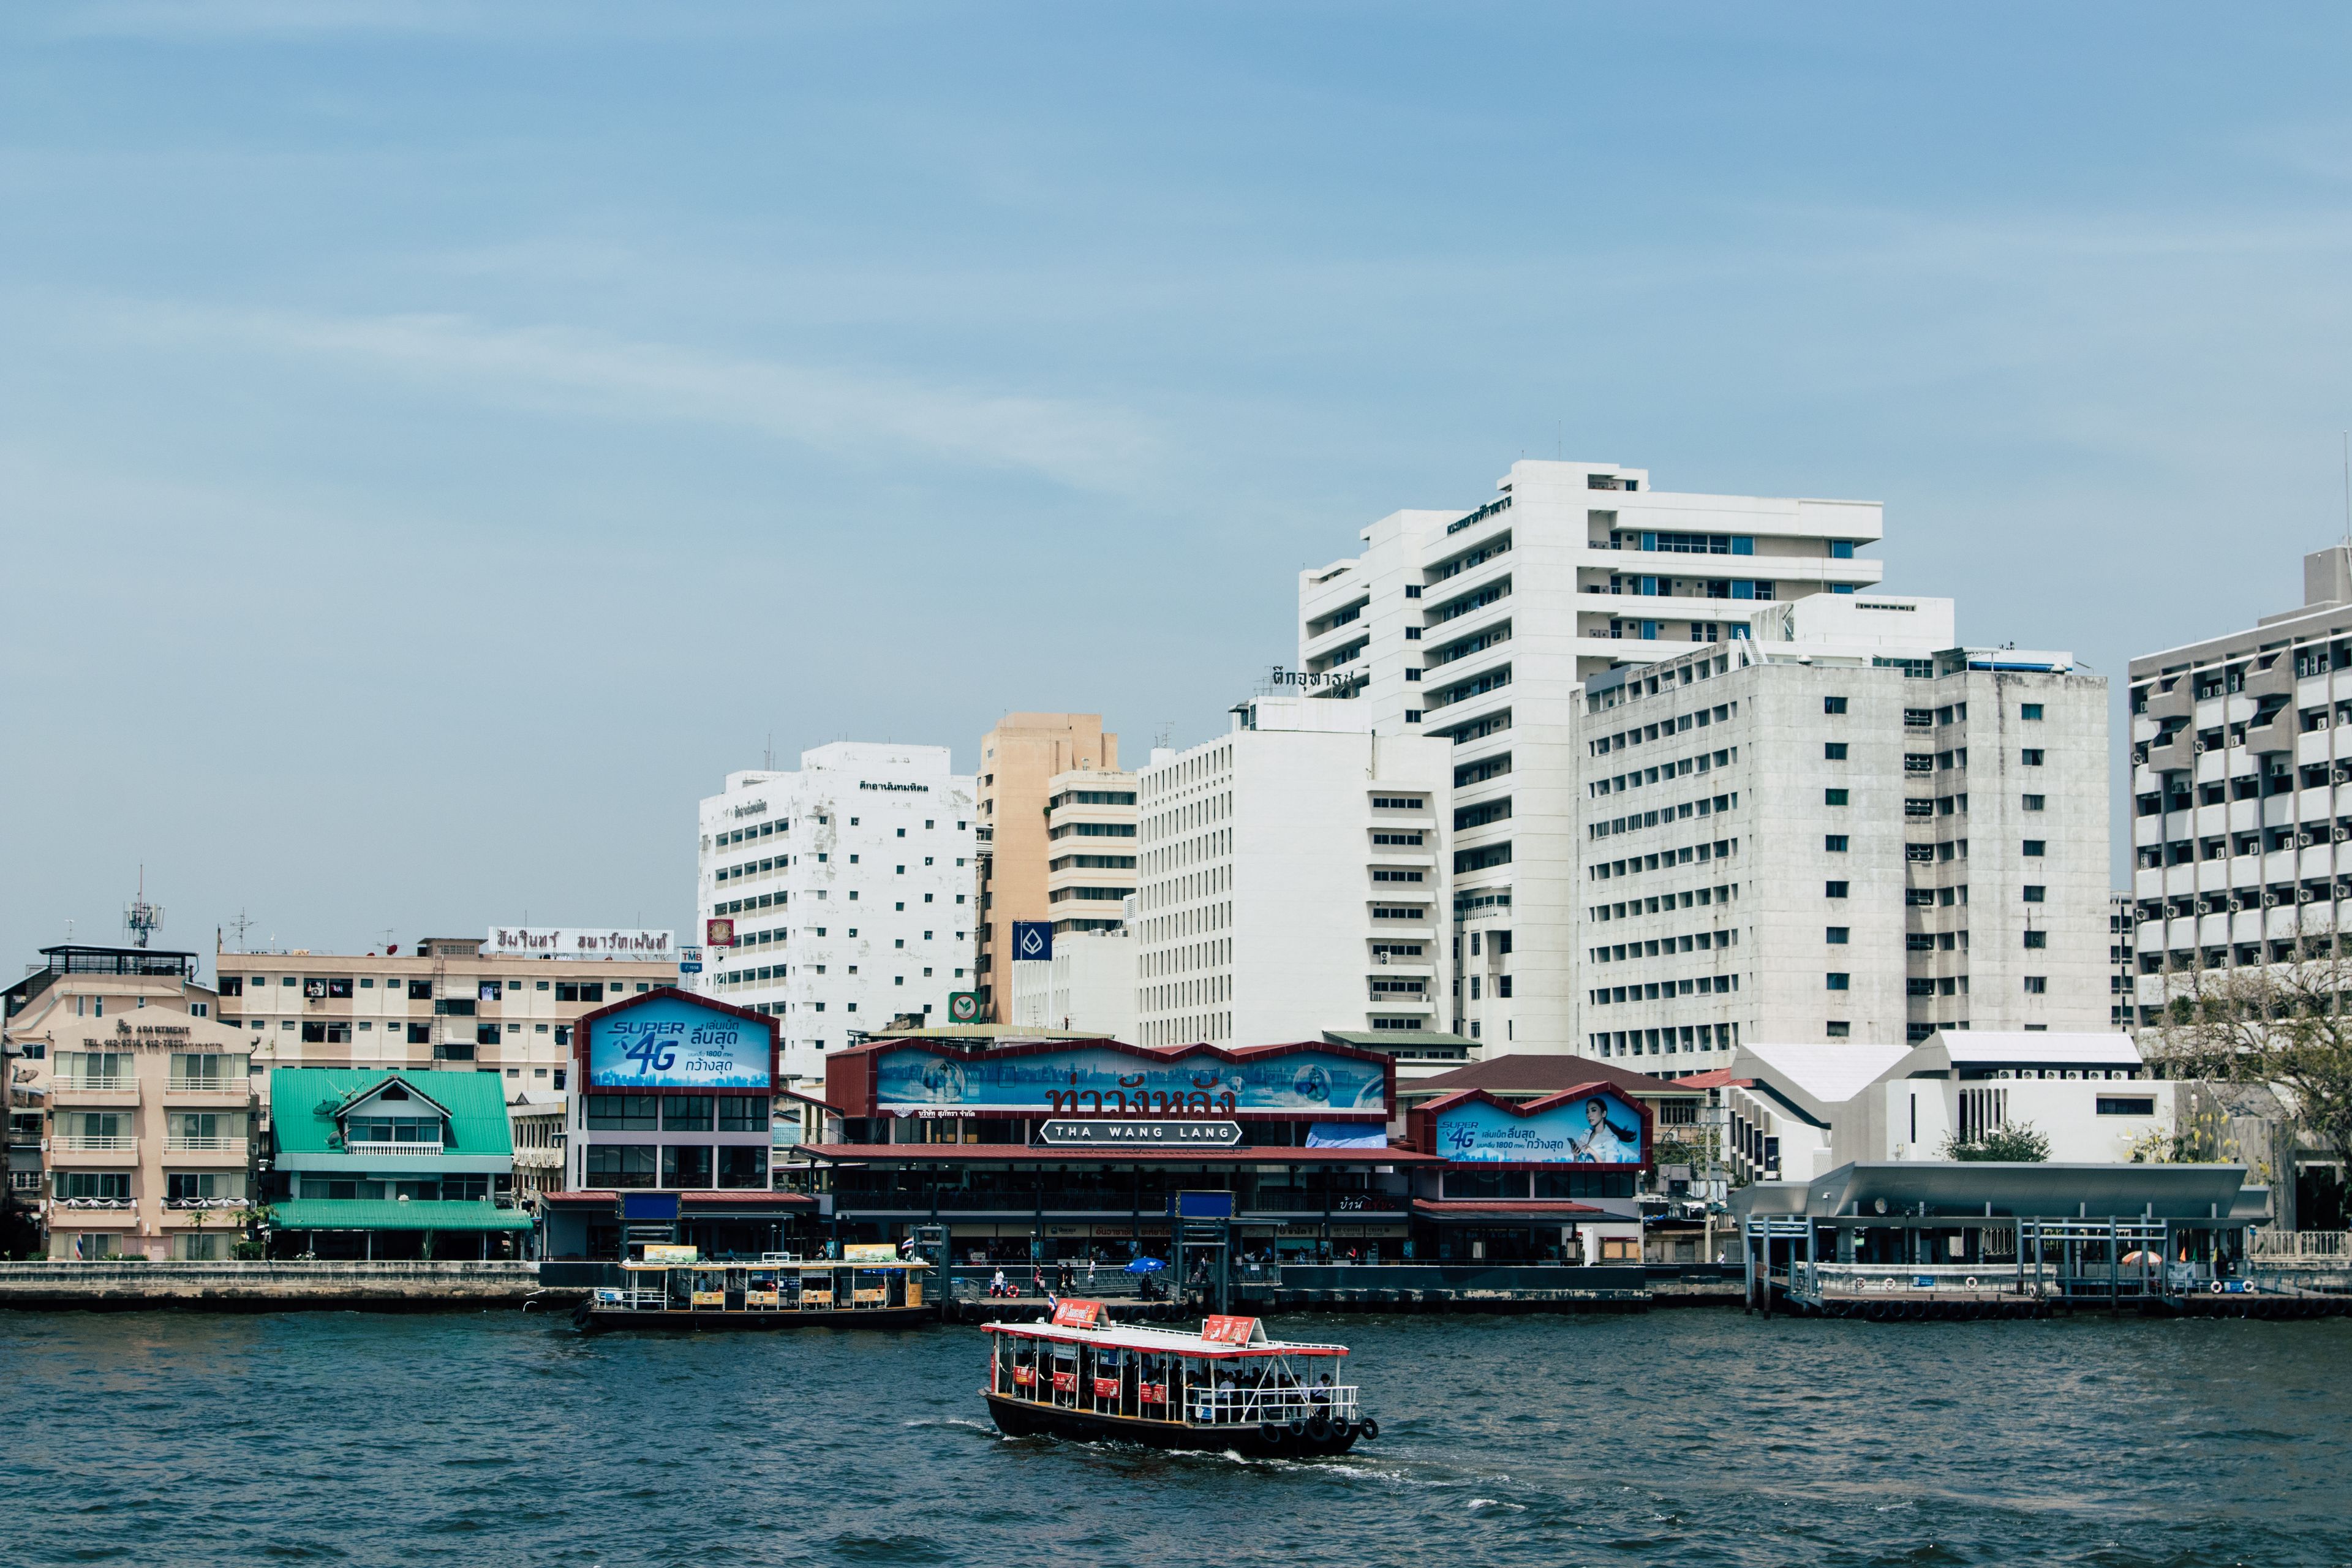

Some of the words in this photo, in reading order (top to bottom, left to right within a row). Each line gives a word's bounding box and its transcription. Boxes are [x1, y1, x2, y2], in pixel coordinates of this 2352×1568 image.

[682, 951, 702, 960] TMB
[137, 1025, 190, 1034] APARTMENT
[608, 1022, 685, 1035] SUPER
[690, 1024, 738, 1049] ลื่นสุด
[625, 1031, 679, 1075] 4G
[685, 1057, 733, 1075] กว้างสุด
[1045, 1072, 1236, 1120] ท่าวังหลัง
[938, 1109, 958, 1118] สุภัทรา
[1055, 1126, 1091, 1137] THA
[1109, 1127, 1163, 1137] WANG
[1180, 1128, 1229, 1137] LANG
[1449, 1126, 1476, 1150] 4G
[1508, 1125, 1536, 1142] ลื่นสุด
[1526, 1138, 1564, 1152] กว้างสุด
